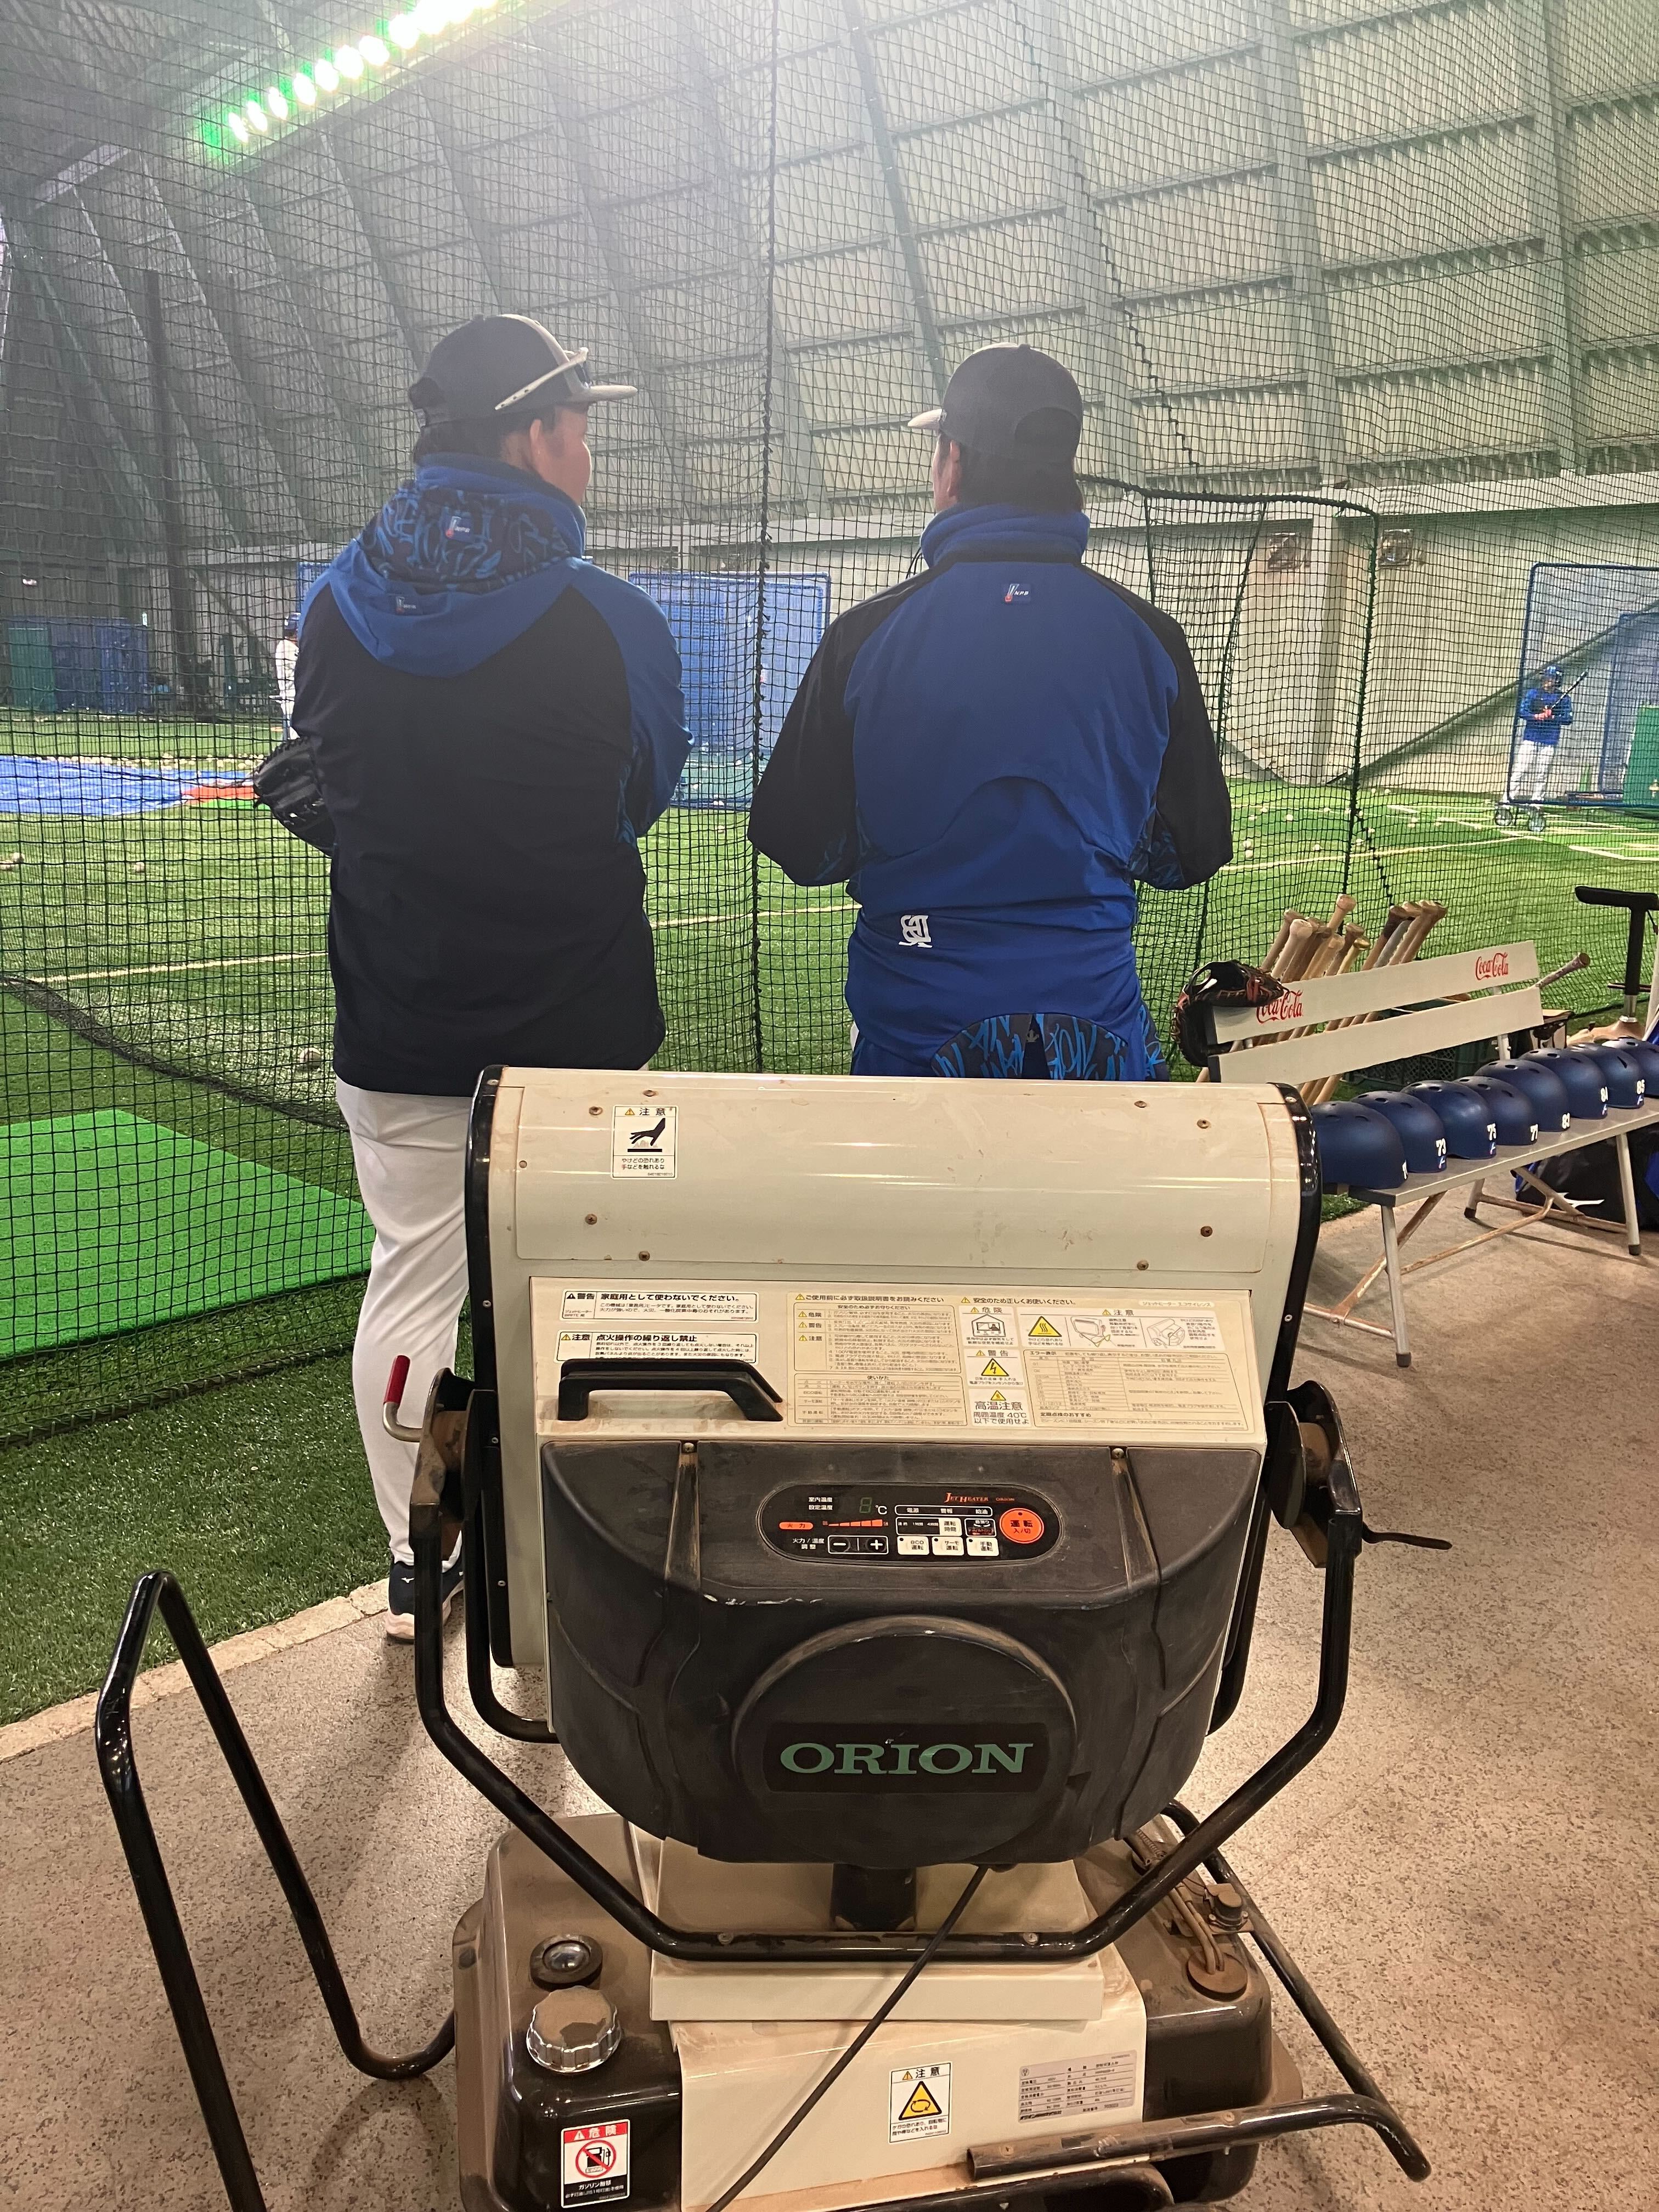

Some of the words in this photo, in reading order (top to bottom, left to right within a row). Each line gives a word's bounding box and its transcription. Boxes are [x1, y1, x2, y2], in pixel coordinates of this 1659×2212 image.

[1637, 1079, 1645, 1094] 85
[639, 1107, 665, 1116] 注意
[1487, 1123, 1497, 1141] 75
[1435, 1138, 1447, 1157] 73
[974, 1401, 1023, 1410] 高温注意
[944, 1492, 957, 1502] JET
[1010, 1520, 1033, 1528] 運転
[780, 1742, 1034, 1775] ORION
[915, 2066, 940, 2079] 注意
[589, 2124, 617, 2138] 危険
